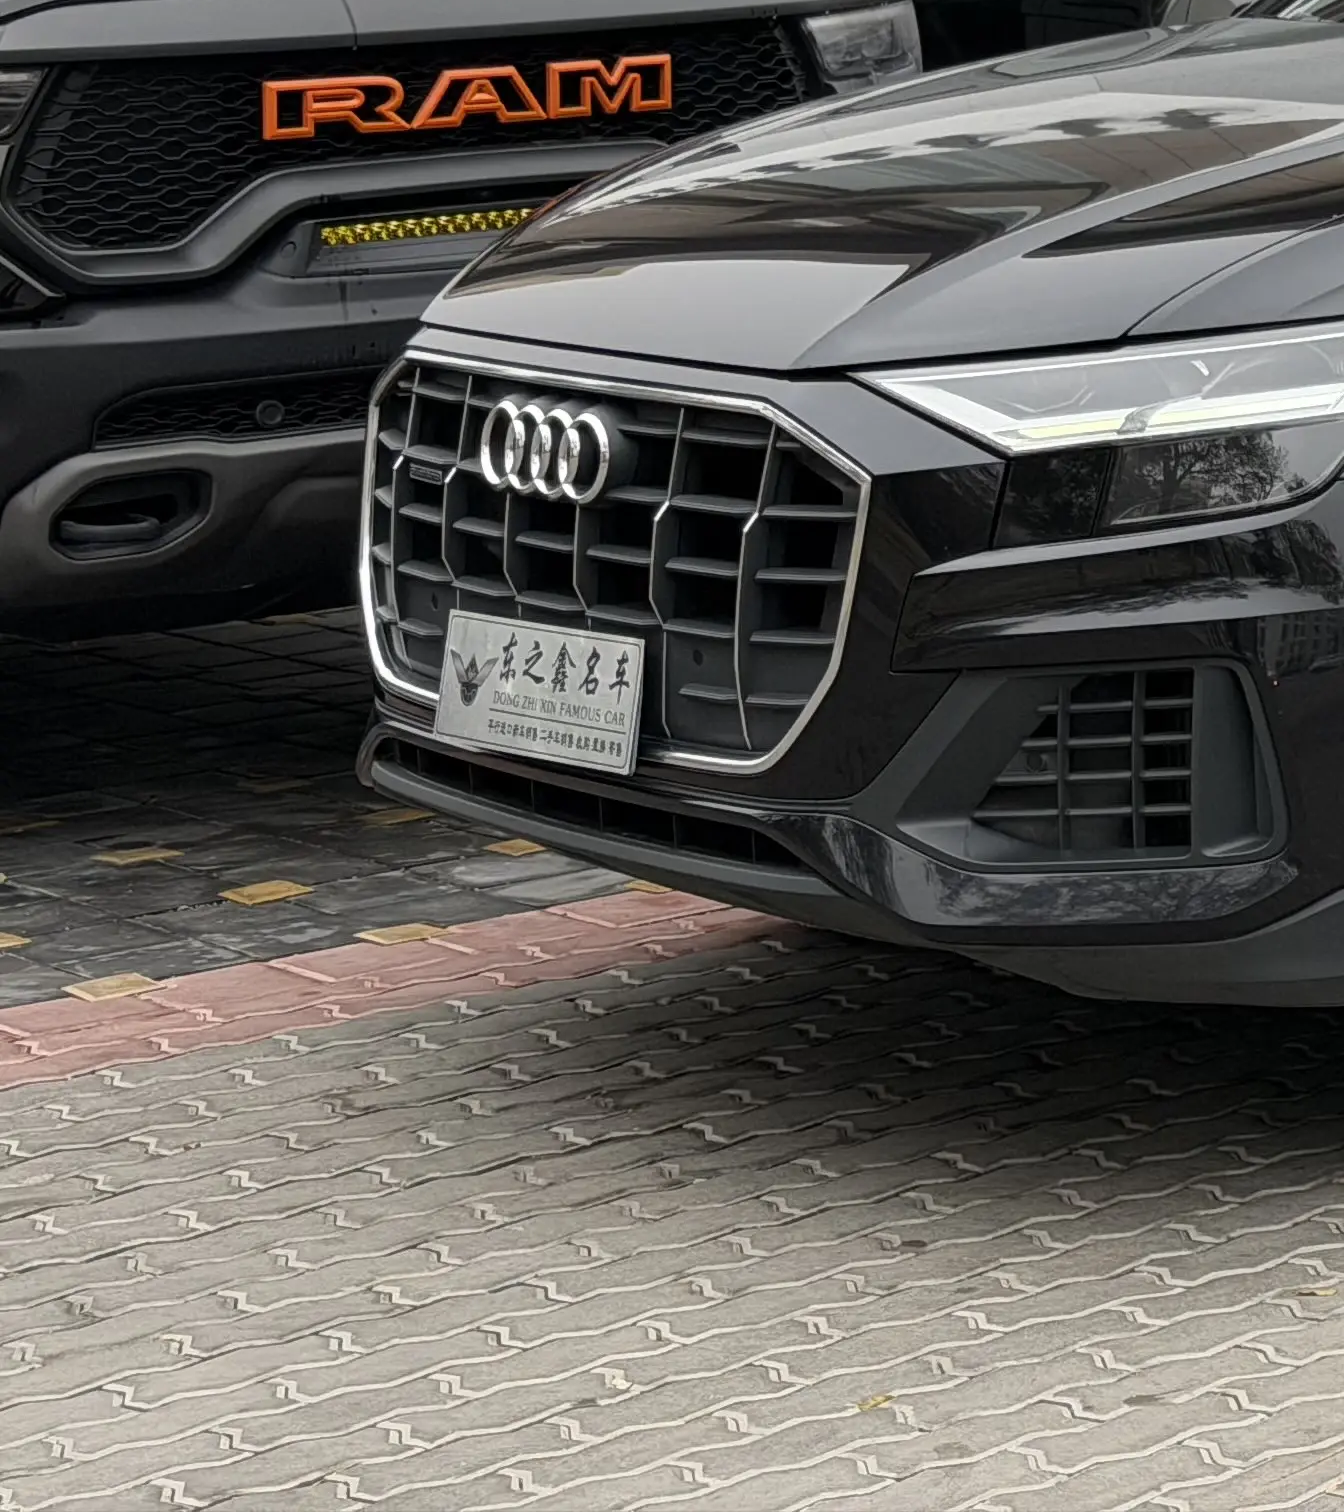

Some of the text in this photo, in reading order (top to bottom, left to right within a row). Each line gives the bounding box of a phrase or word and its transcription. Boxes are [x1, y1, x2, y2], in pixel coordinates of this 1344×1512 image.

[262, 53, 673, 141] RAM
[499, 631, 631, 705] 东之鑫名车
[493, 690, 626, 727] DONG ZHI XIN FAMOUS CAR
